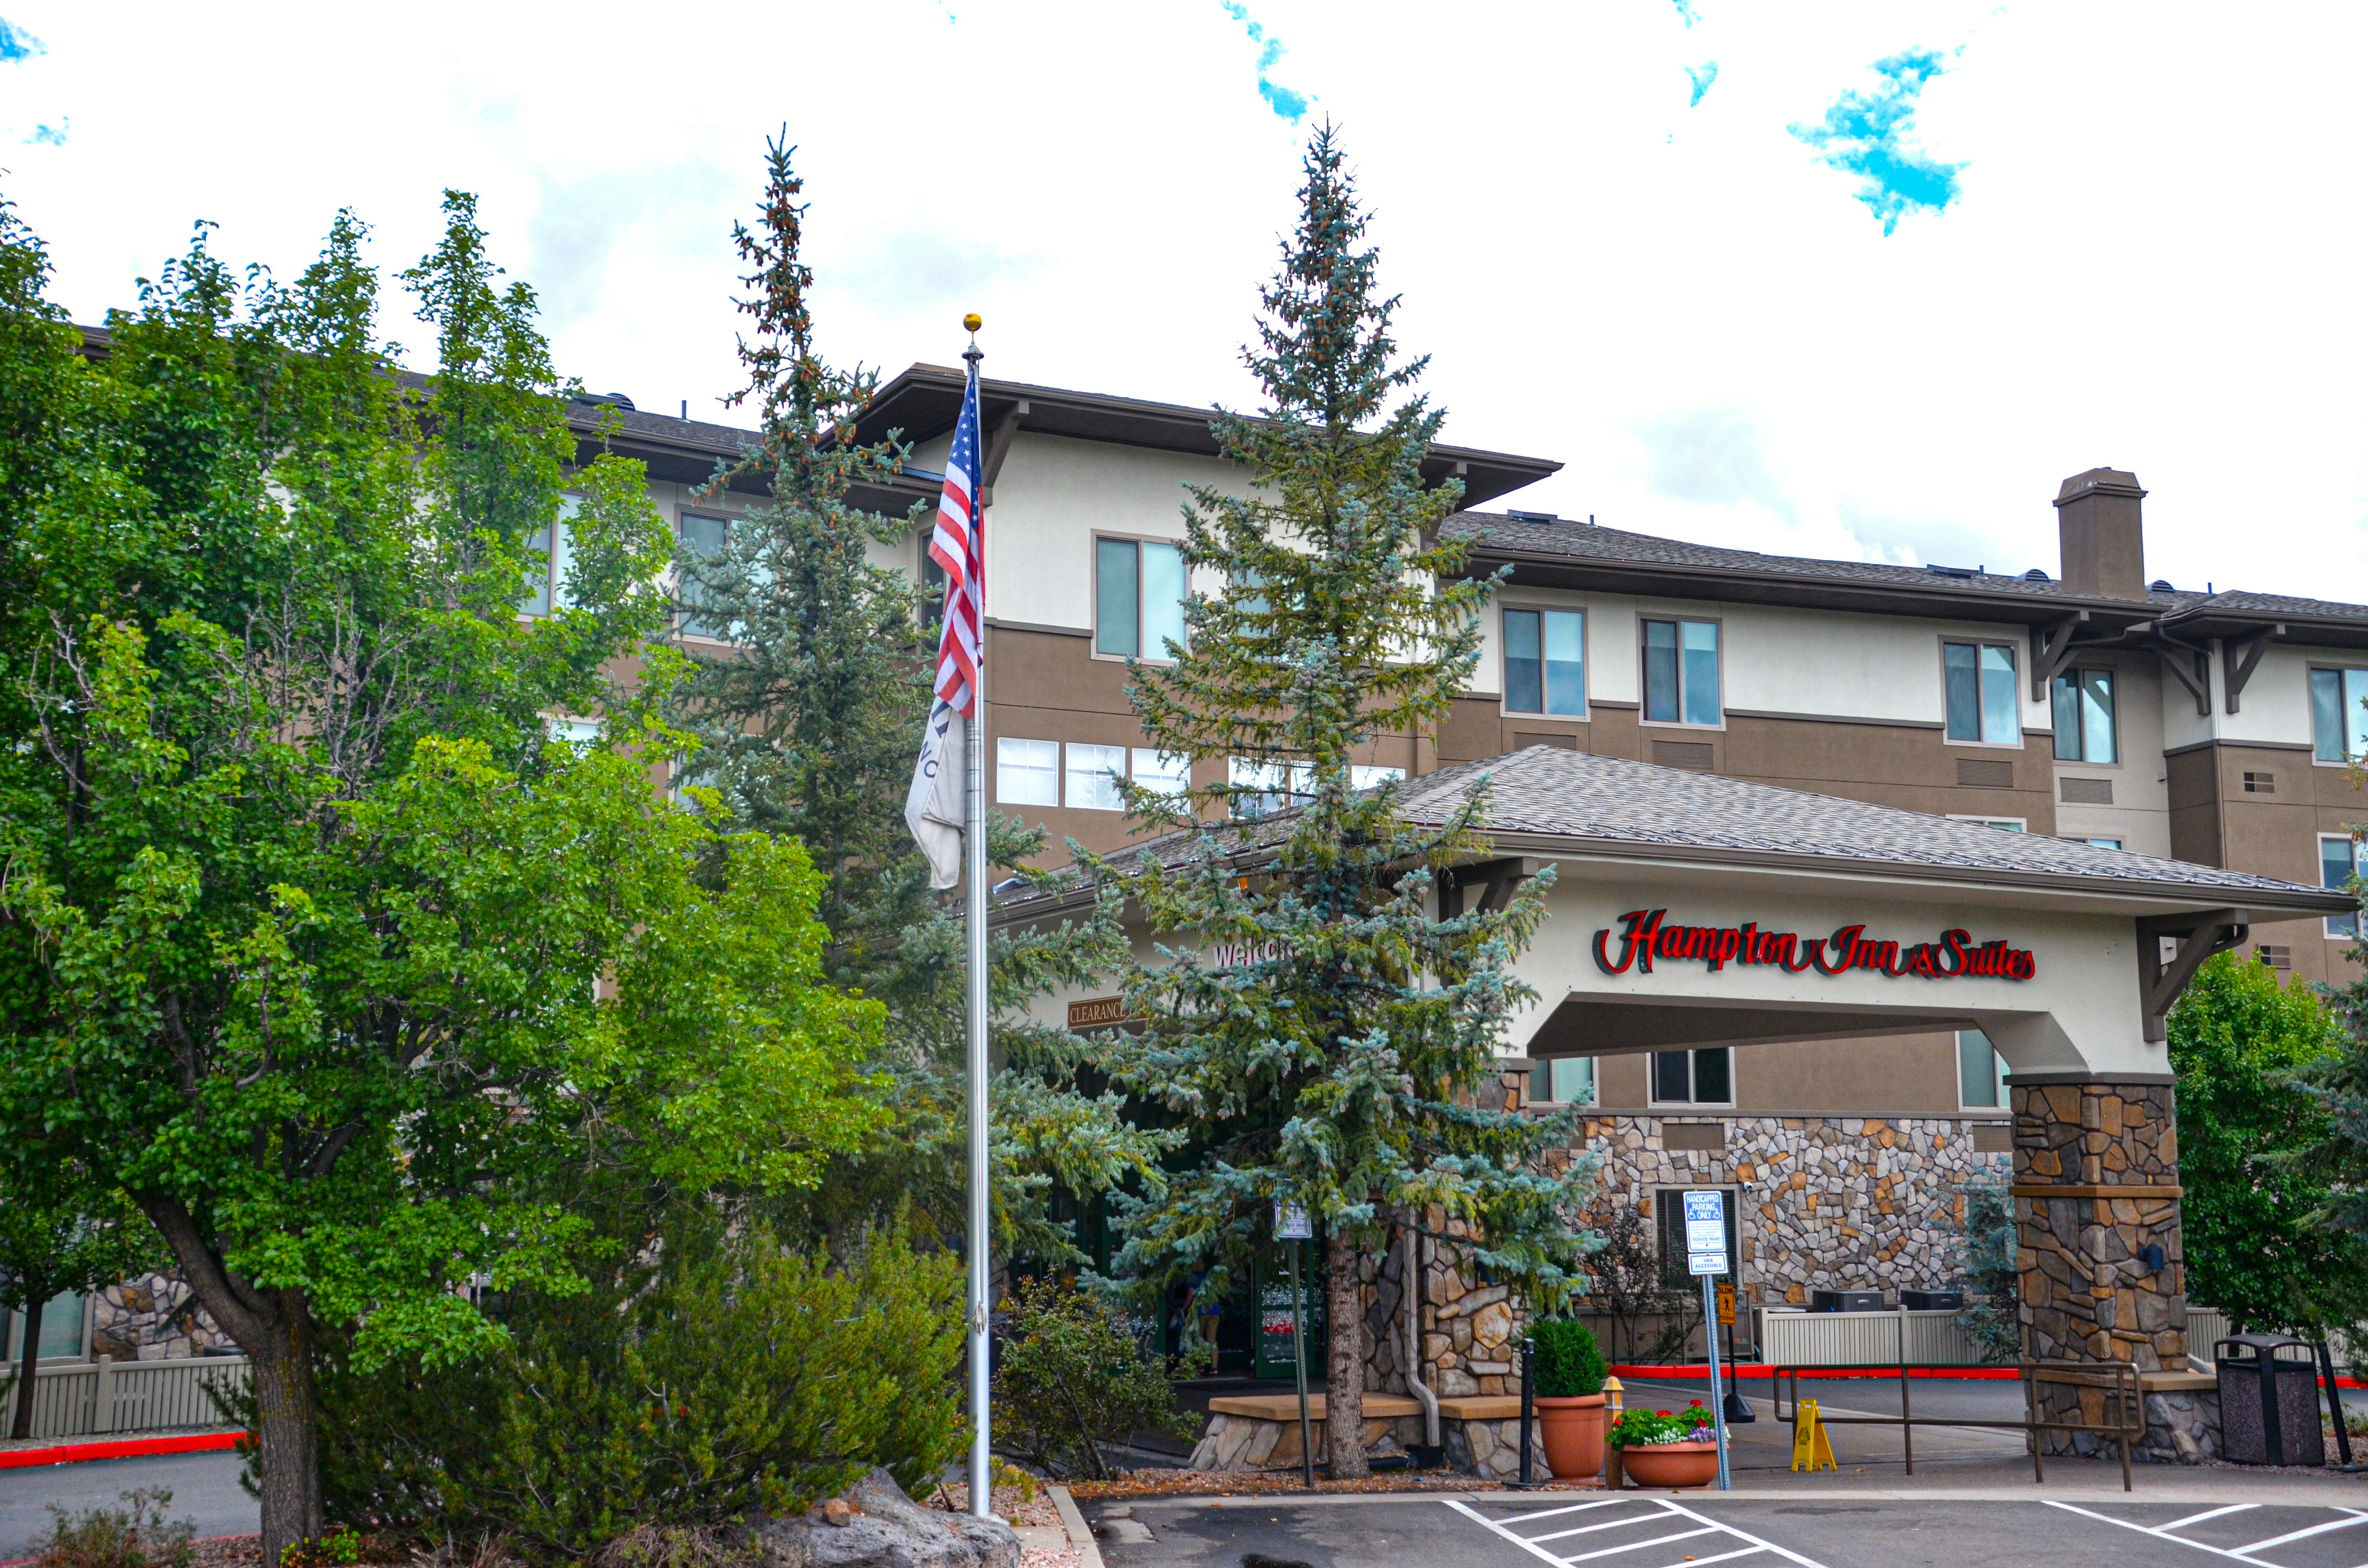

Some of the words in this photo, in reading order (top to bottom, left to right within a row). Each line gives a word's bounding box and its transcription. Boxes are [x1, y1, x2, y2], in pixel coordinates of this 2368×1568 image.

[1594, 908, 1815, 974] Hampton
[1819, 924, 1915, 976] Inn
[1916, 943, 1941, 978] &
[1936, 929, 2035, 980] Suites
[1070, 1002, 1126, 1023] CLEARANCE
[1686, 1194, 1719, 1203] HANDICAPPED
[1692, 1202, 1715, 1211] PARKING
[1697, 1211, 1712, 1219] ONLY
